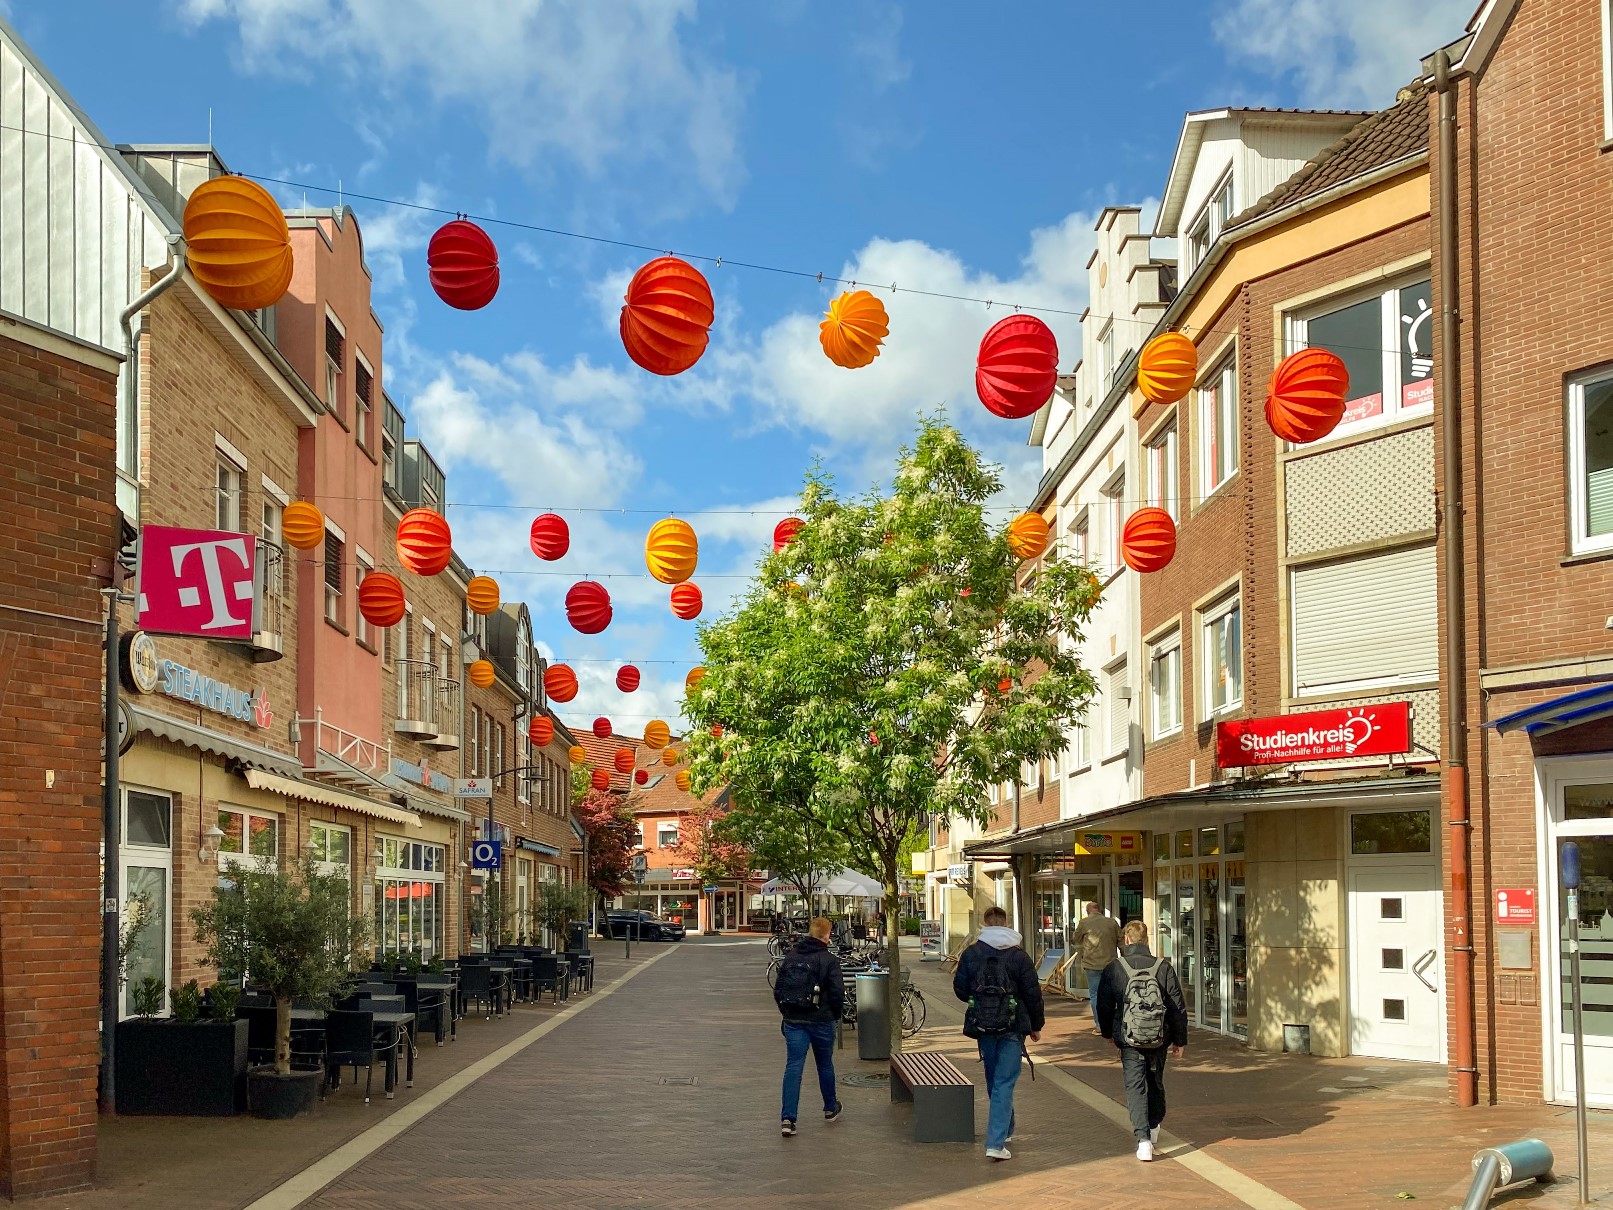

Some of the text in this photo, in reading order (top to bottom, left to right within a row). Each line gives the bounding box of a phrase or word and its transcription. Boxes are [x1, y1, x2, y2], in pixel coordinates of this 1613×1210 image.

[170, 538, 250, 630] T
[163, 659, 251, 722] STEAKHAUS
[1240, 724, 1354, 751] Studienkreis
[1254, 744, 1344, 760] Profi-Nachhilfe für alle!
[475, 843, 498, 866] O2
